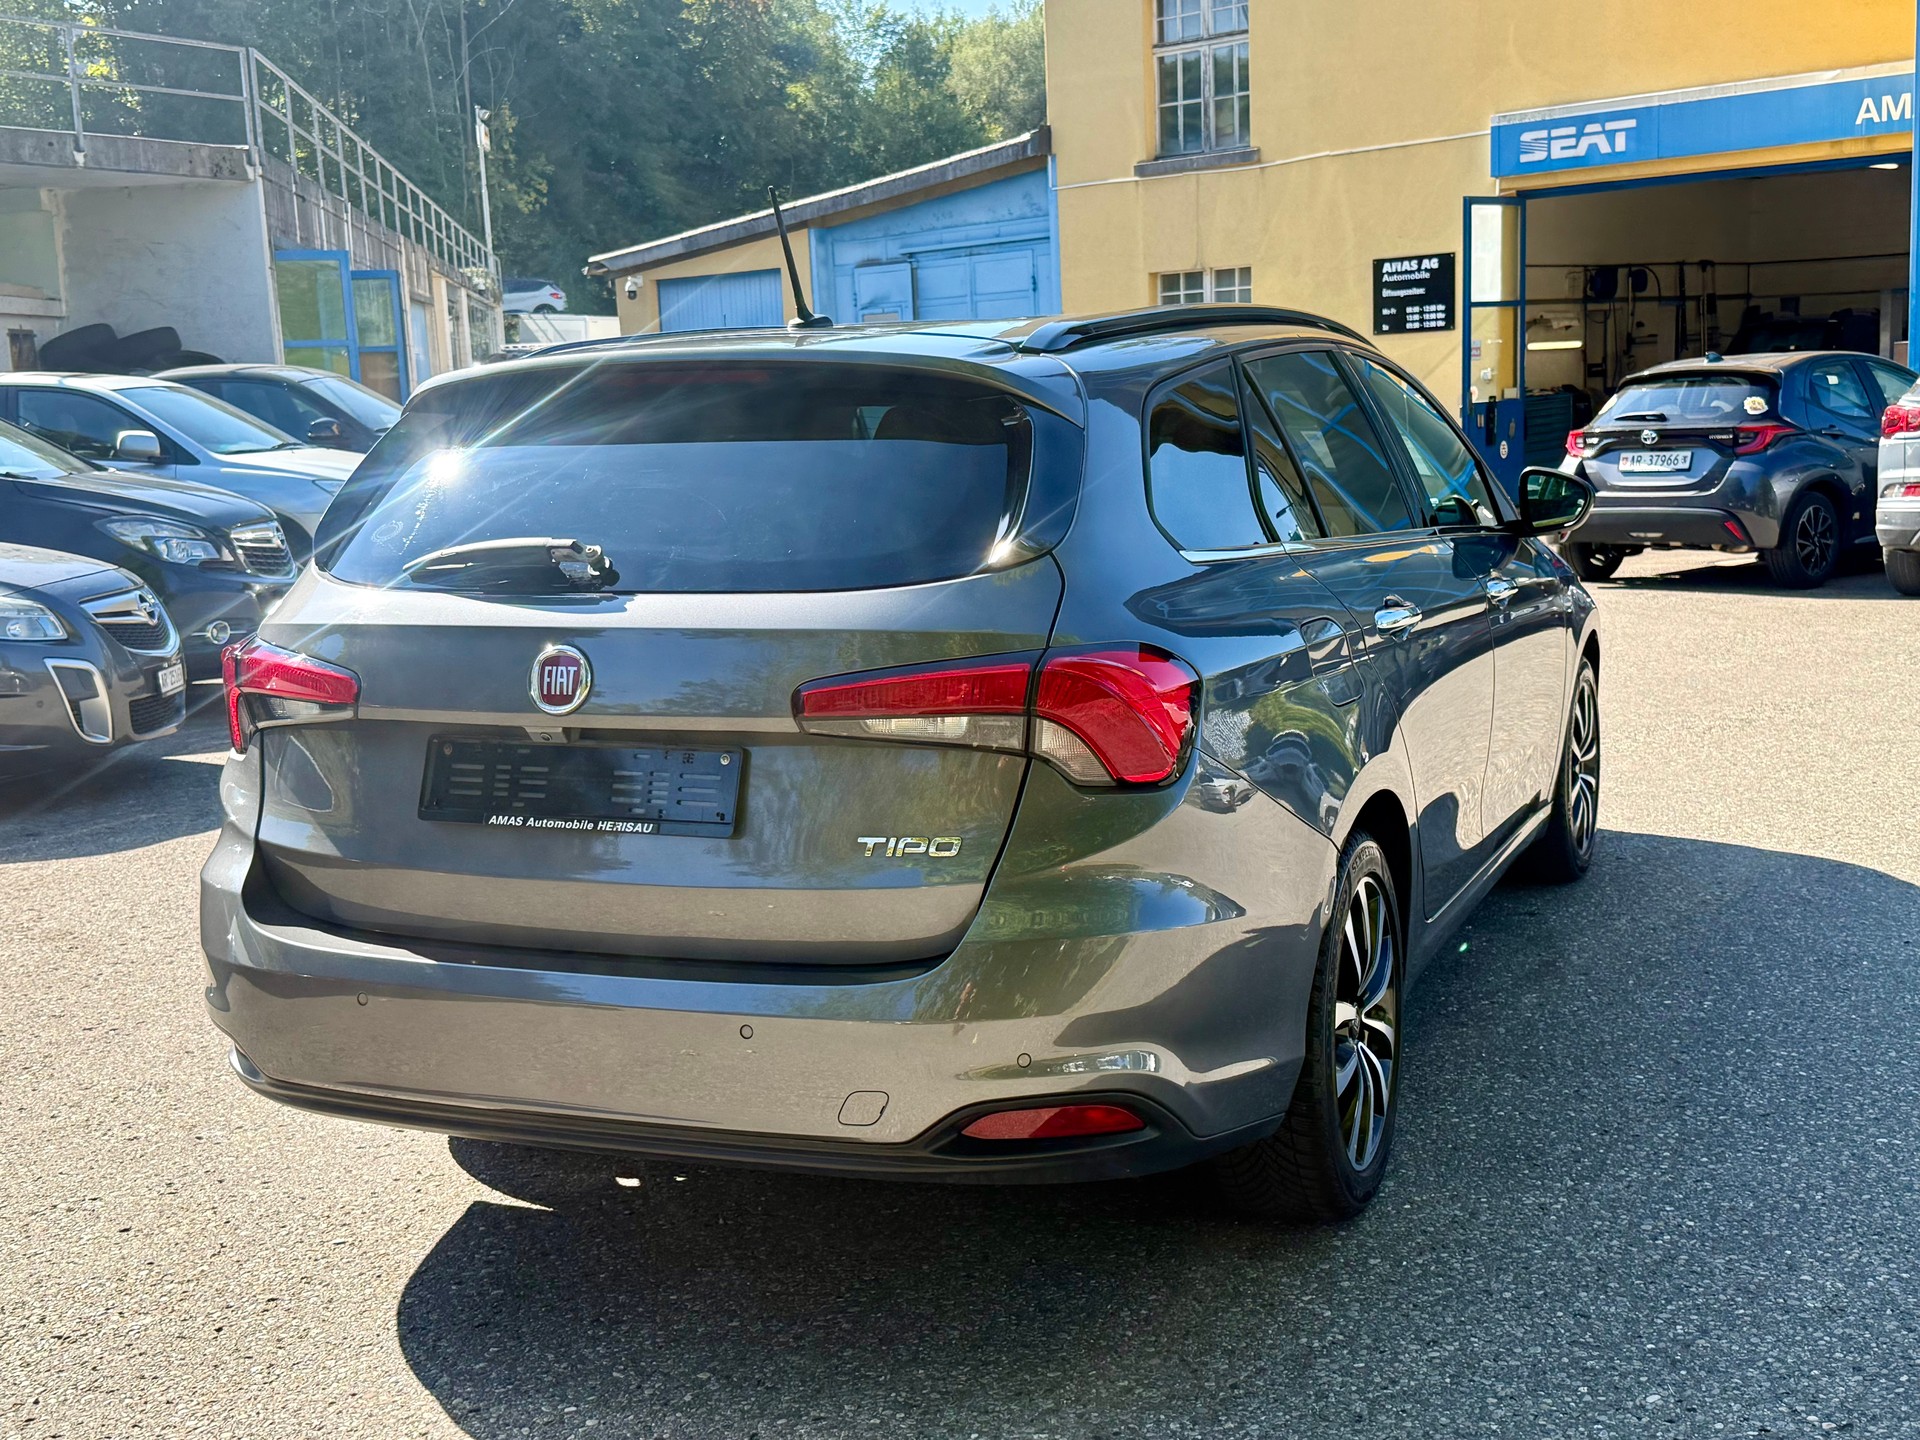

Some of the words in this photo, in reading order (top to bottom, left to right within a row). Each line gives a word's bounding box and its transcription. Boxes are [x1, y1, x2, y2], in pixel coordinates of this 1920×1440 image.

[1855, 92, 1914, 126] AM
[1519, 118, 1637, 164] SEAT
[1421, 258, 1439, 270] AG
[1382, 271, 1430, 283] Automobile
[543, 666, 577, 695] FIAT
[488, 815, 523, 826] AMAS
[526, 817, 594, 830] Automobile
[597, 820, 654, 833] HERISAU
[857, 837, 962, 857] TIPO
